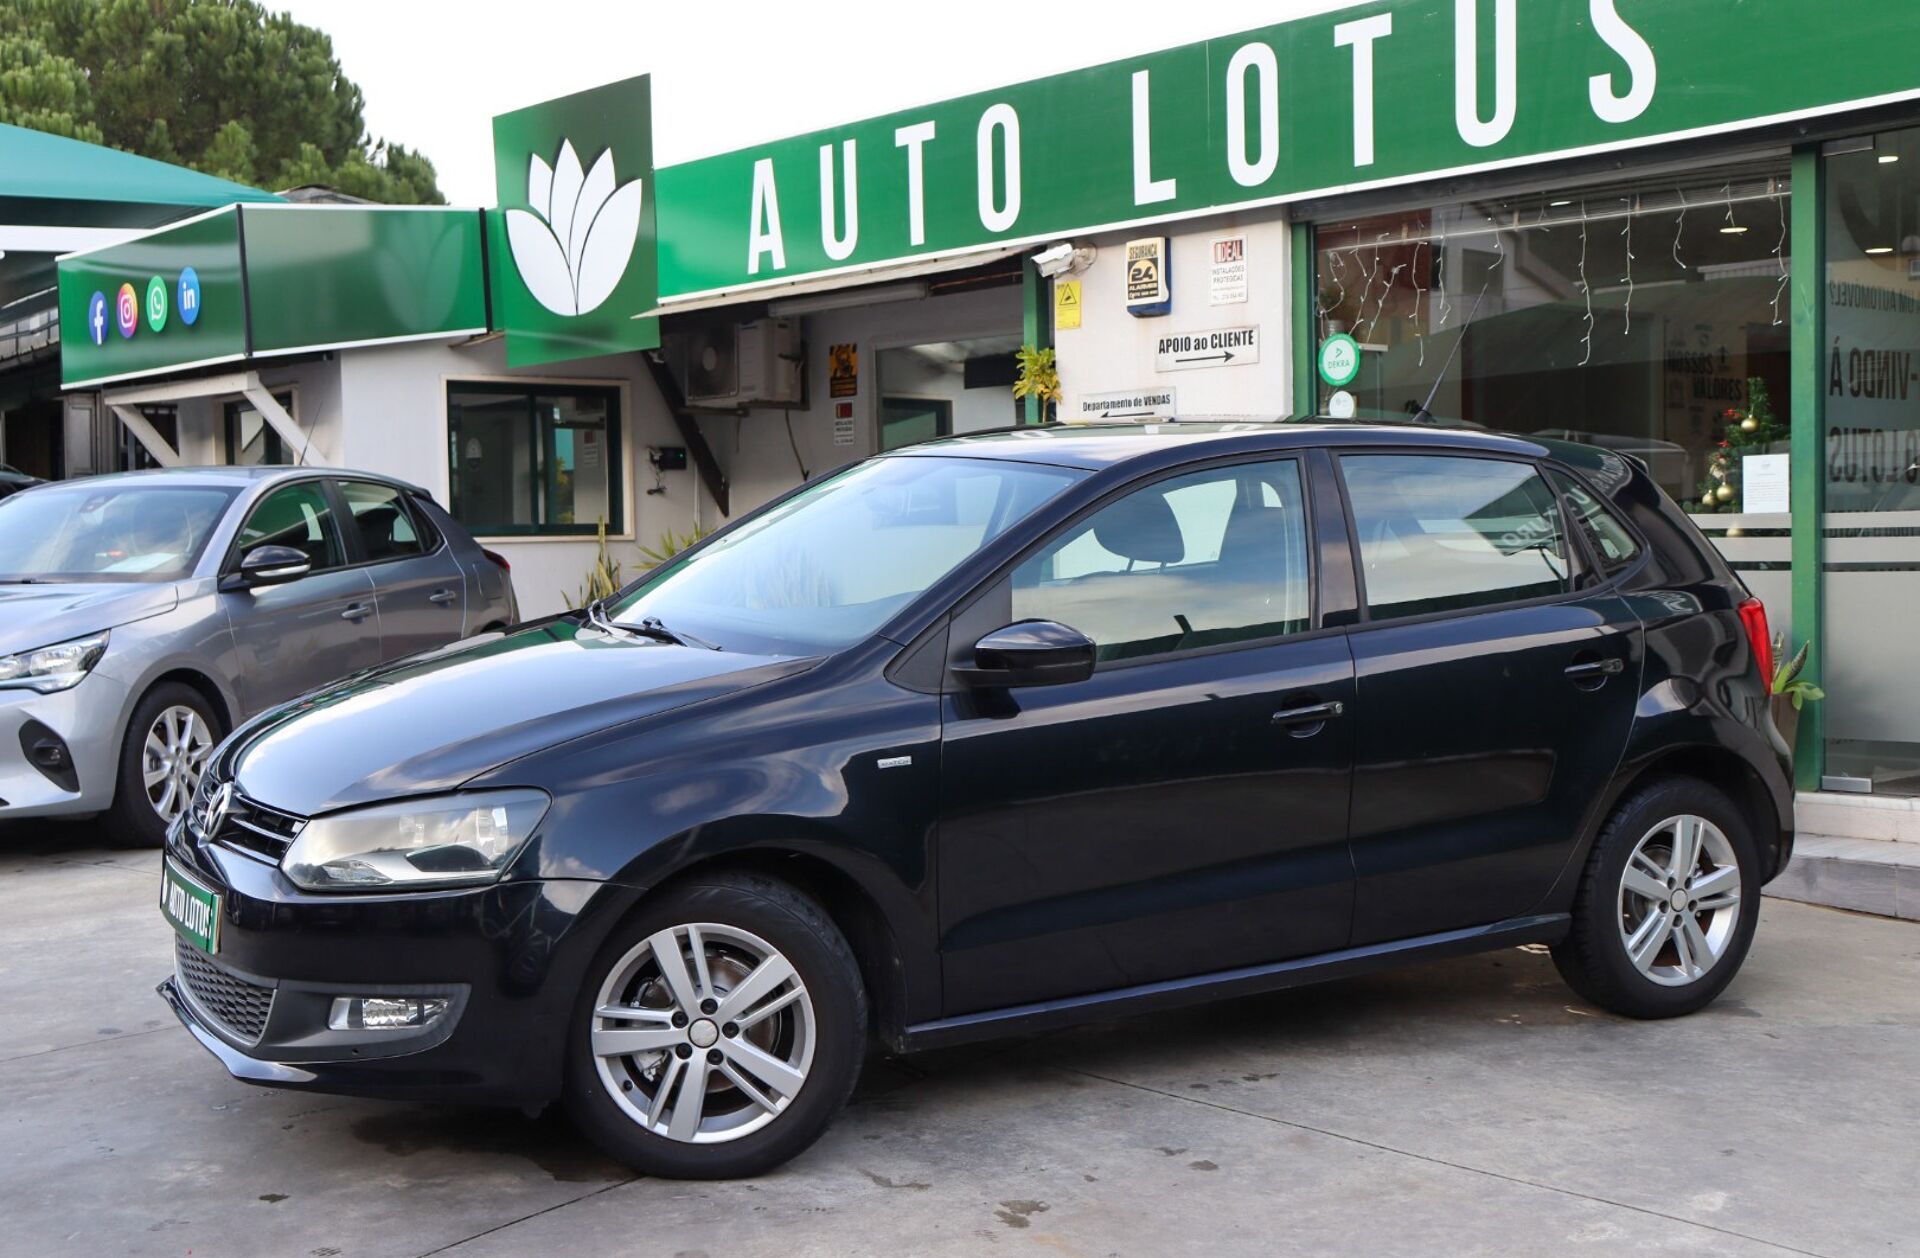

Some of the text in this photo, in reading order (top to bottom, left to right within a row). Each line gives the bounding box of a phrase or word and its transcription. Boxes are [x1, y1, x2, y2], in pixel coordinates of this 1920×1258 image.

[748, 0, 1657, 275] AUTO LOTUS
[1131, 265, 1154, 282] 24
[1158, 329, 1254, 354] APOIO ao CLIENTE
[1327, 359, 1350, 369] DEKRA
[1082, 394, 1171, 412] Departamento de VENDAS
[169, 880, 185, 922] AUTO
